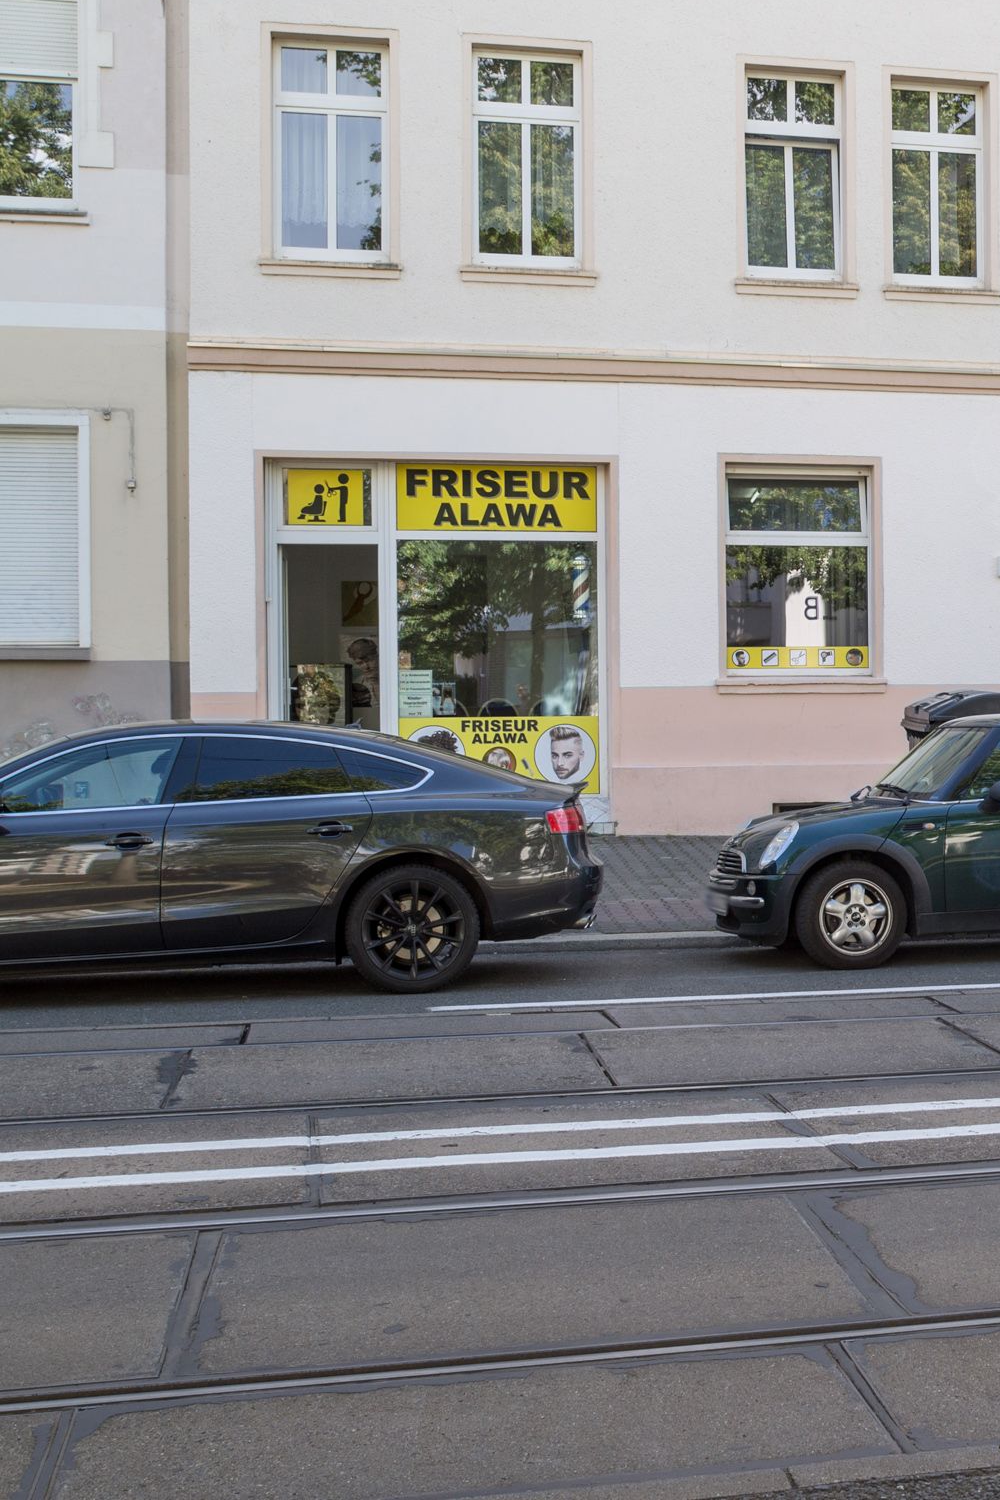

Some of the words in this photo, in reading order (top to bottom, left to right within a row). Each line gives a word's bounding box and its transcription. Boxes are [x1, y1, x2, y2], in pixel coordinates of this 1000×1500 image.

[406, 469, 590, 499] FRISEUR
[434, 503, 562, 527] ALAWA
[461, 719, 539, 732] FRISEUR
[471, 733, 528, 744] ALAWA
